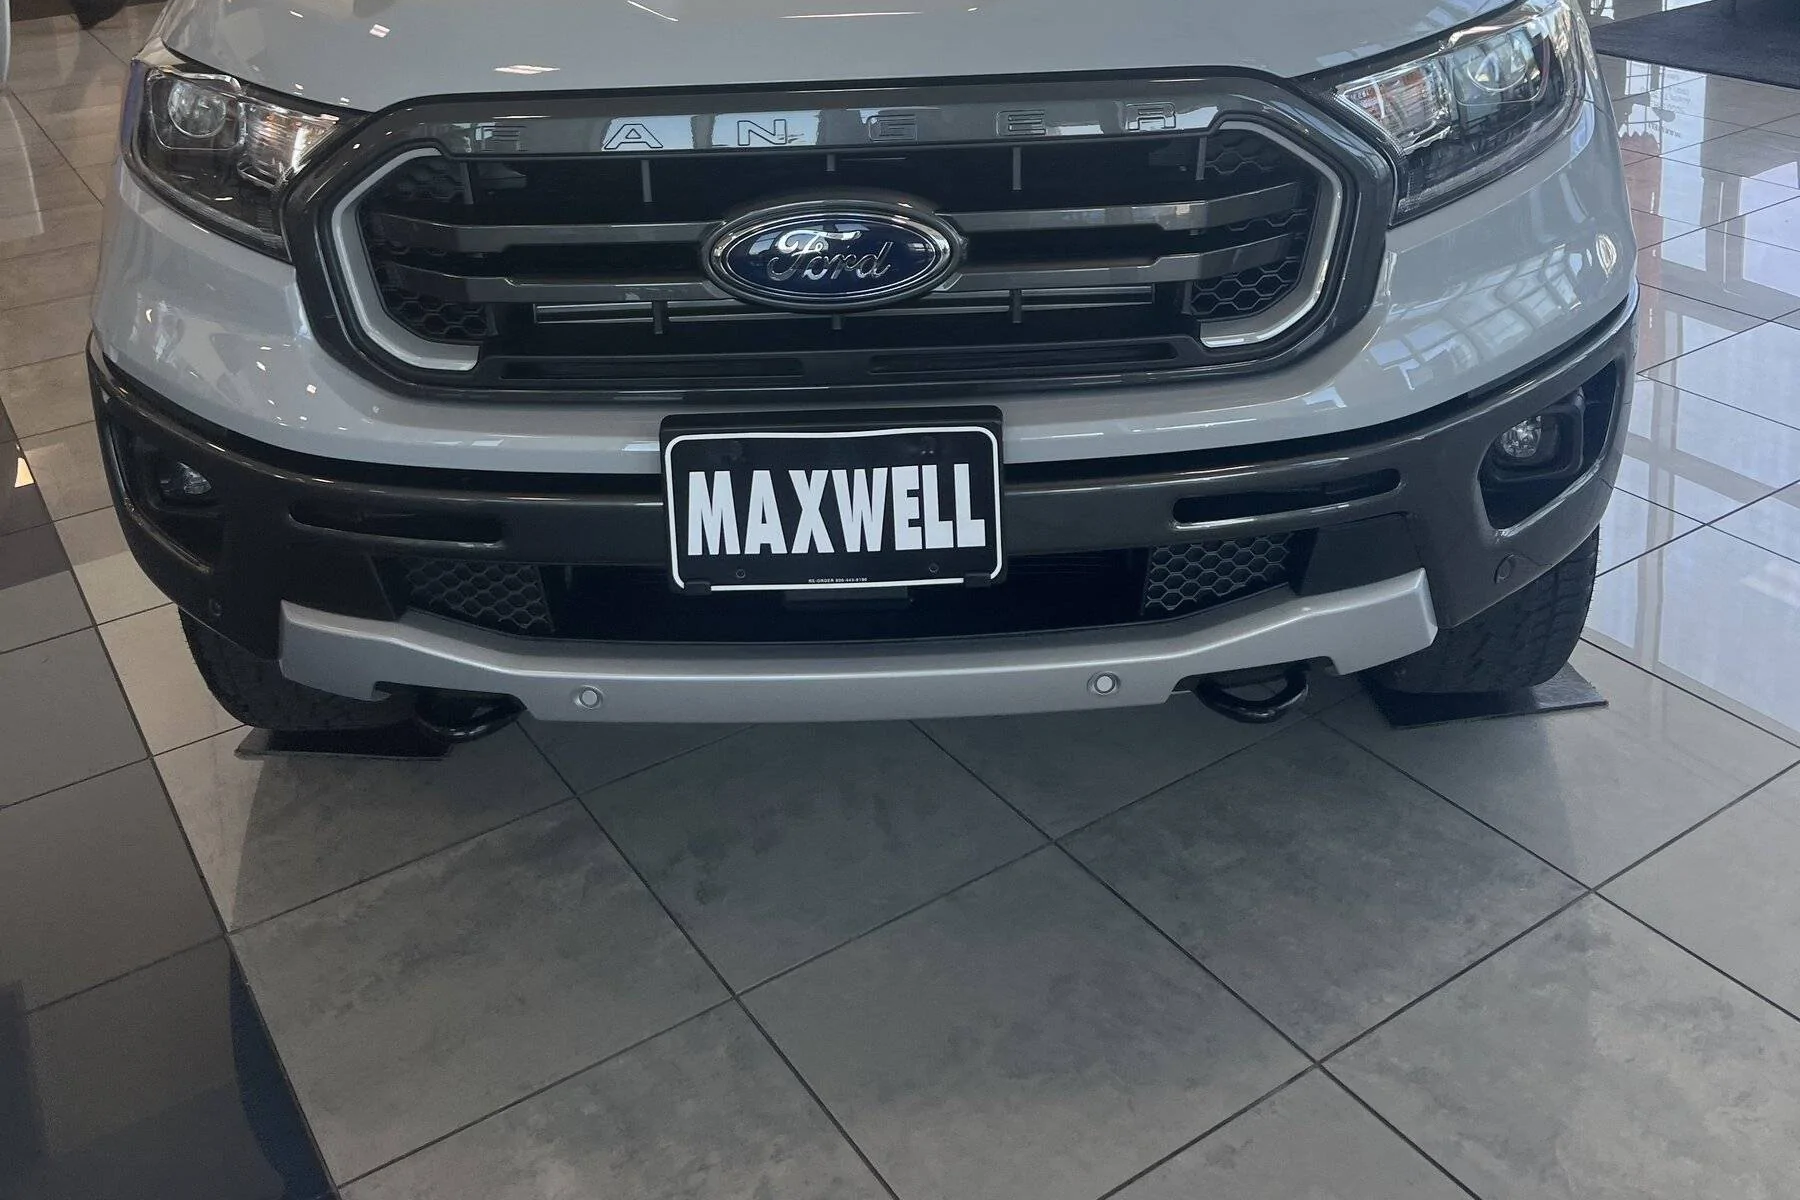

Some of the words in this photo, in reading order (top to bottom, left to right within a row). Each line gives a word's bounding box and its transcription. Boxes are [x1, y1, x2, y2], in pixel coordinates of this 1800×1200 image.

[475, 102, 1177, 151] RANGER
[766, 229, 894, 282] Ford
[687, 463, 986, 556] MAXWELL
